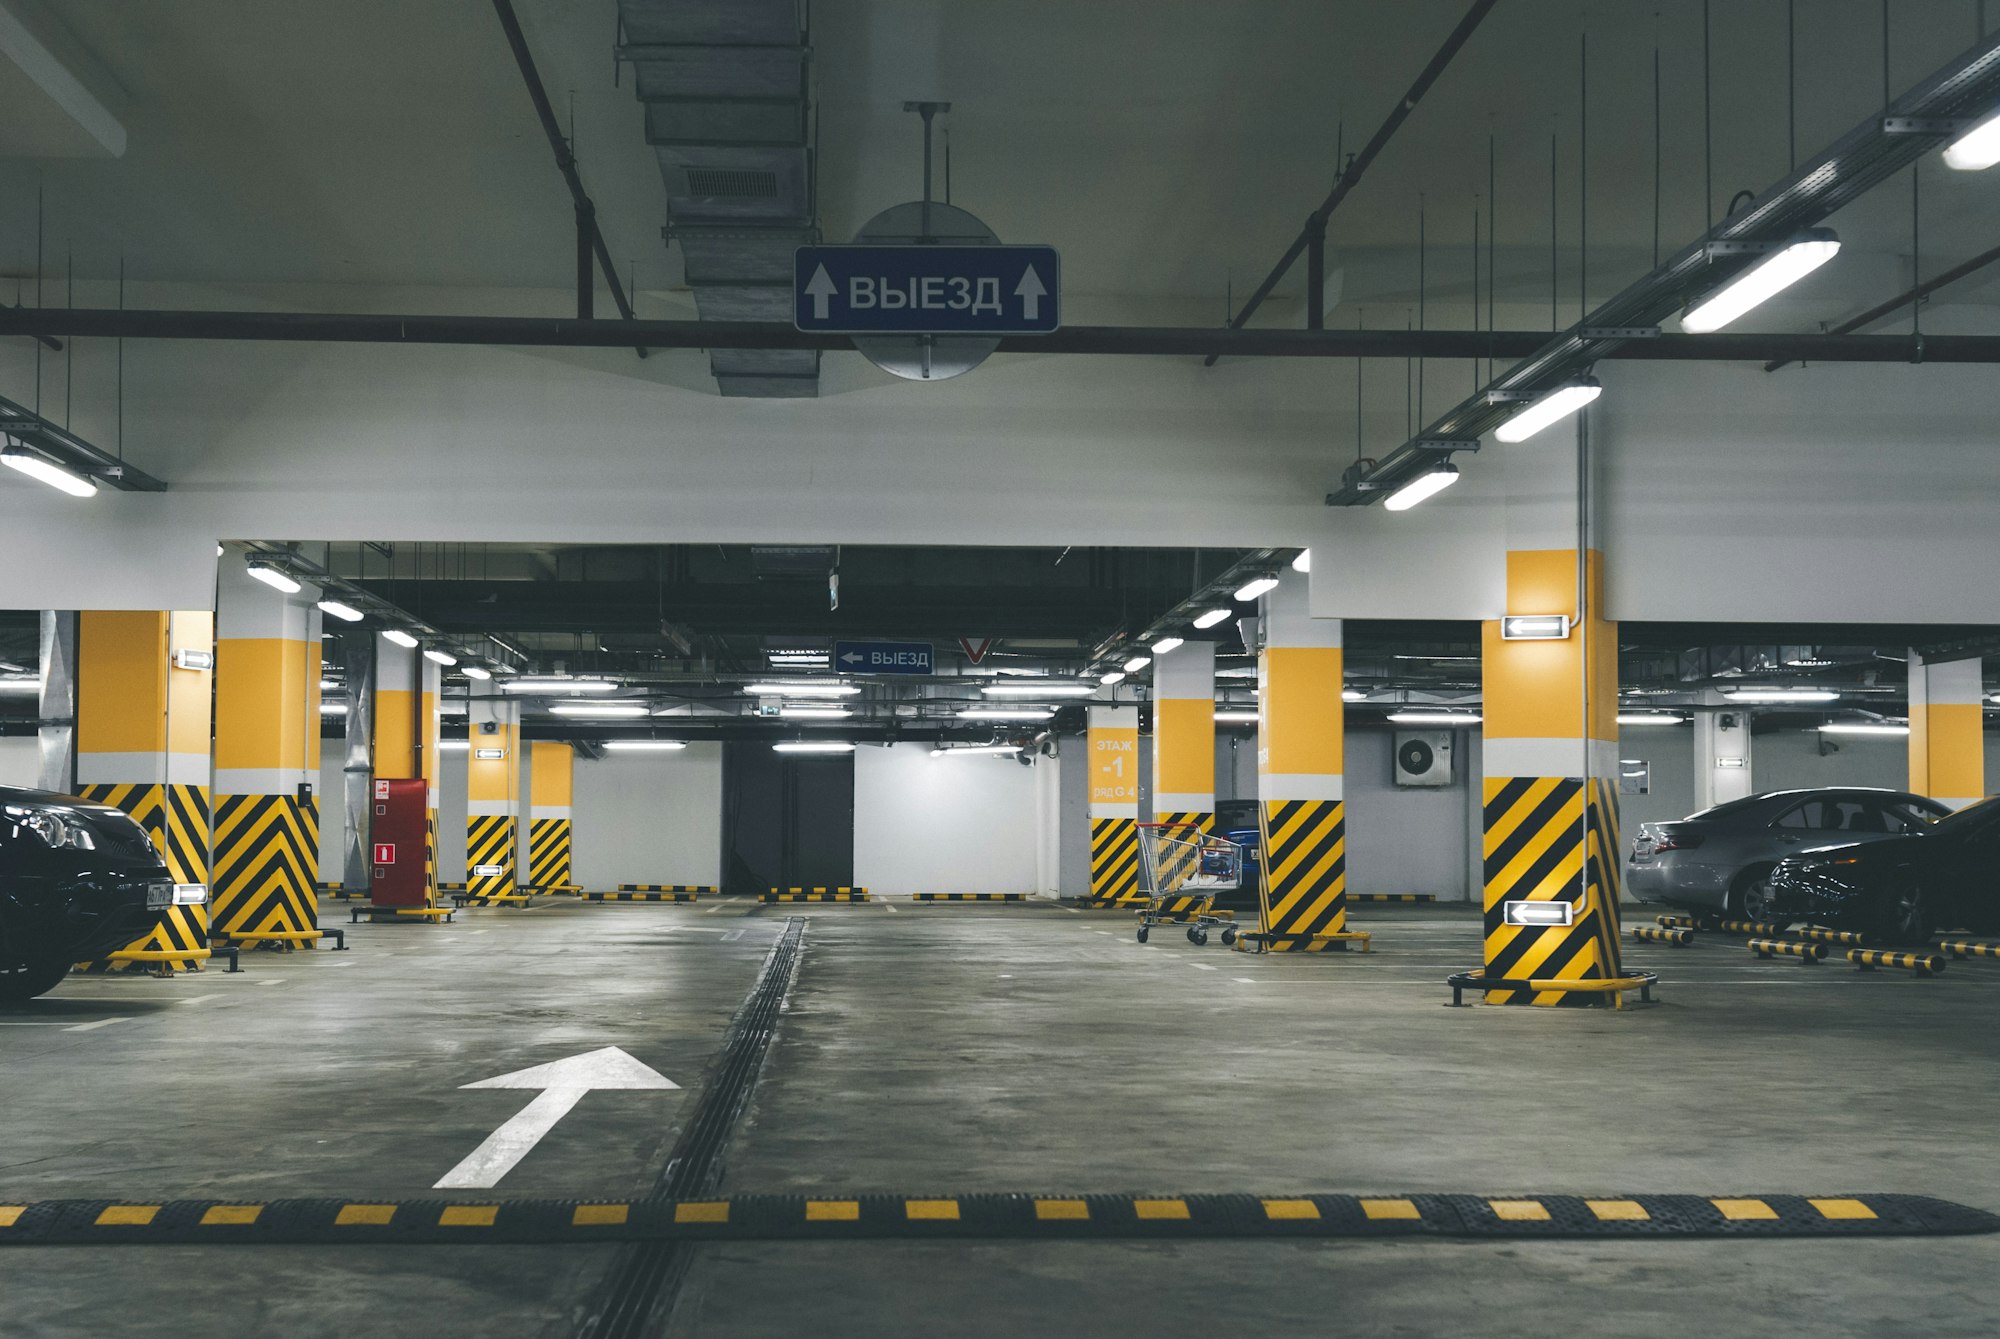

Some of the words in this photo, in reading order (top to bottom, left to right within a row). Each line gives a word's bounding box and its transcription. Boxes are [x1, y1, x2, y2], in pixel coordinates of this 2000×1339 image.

[849, 277, 1003, 316] ВЫЕЗД
[871, 651, 929, 668] ВЫЕЗД
[1097, 740, 1133, 751] ЭТАЖ
[1103, 755, 1123, 778] -1
[1094, 787, 1113, 800] ряд
